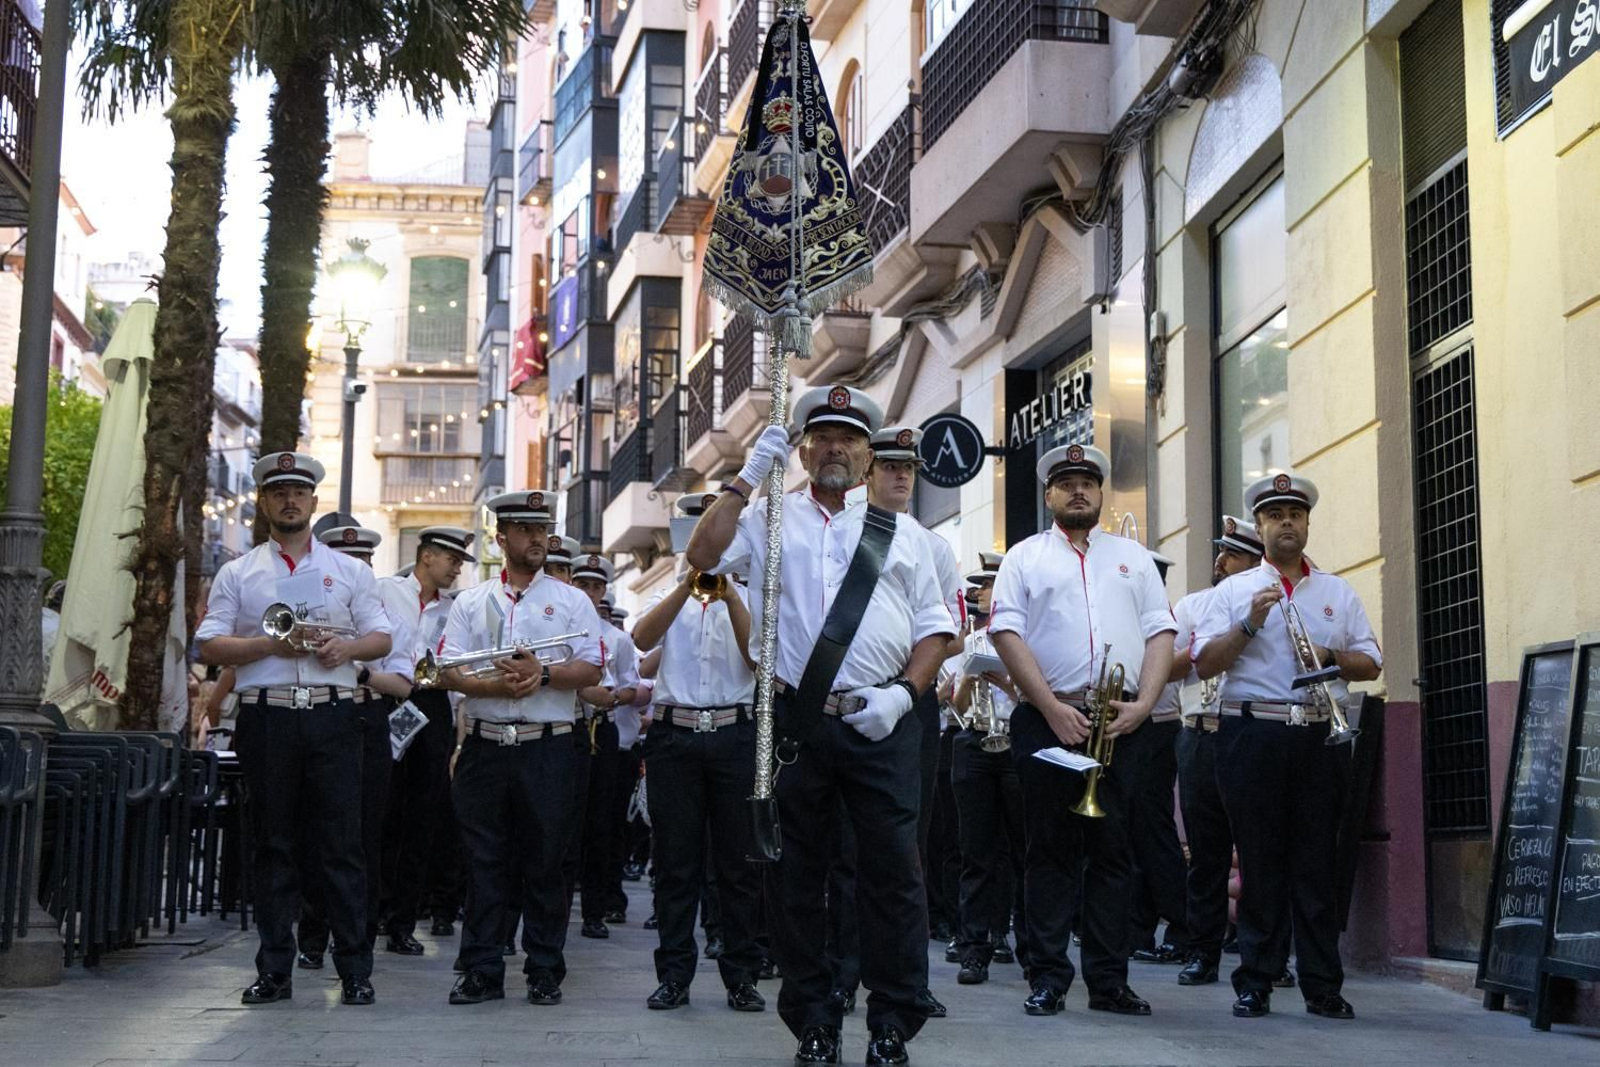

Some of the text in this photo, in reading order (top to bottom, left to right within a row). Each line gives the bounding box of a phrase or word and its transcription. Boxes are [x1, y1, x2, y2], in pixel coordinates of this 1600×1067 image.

[1530, 0, 1600, 82] El S
[803, 79, 813, 106] SALAS
[805, 109, 816, 138] COUTO
[758, 266, 788, 281] JAEN
[1010, 372, 1086, 449] ATELIER
[930, 472, 969, 483] ATELIER
